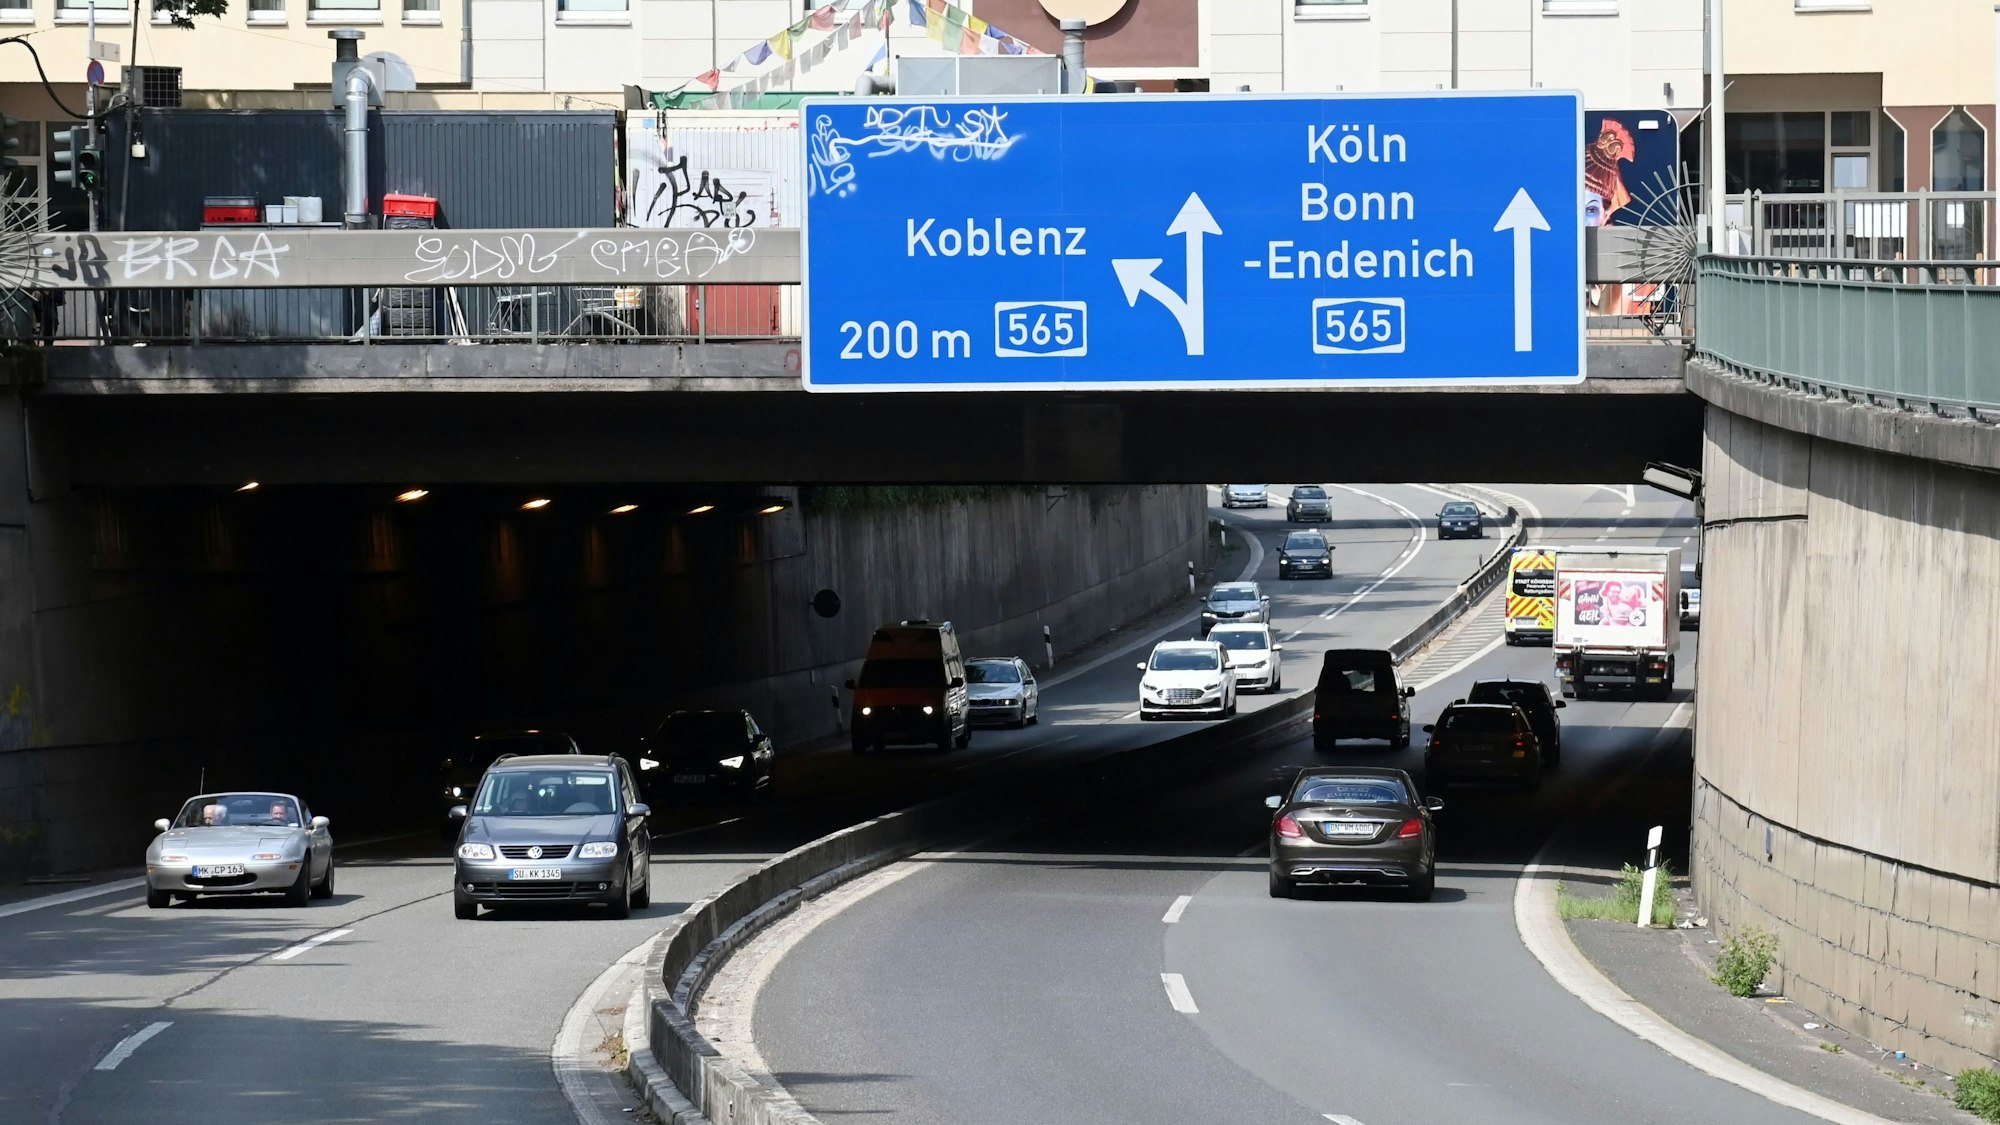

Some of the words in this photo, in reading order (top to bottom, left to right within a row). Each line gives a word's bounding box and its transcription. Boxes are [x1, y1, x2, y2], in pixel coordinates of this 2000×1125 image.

[1308, 124, 1407, 163] Köln
[1302, 182, 1414, 221] Bonn
[907, 217, 1087, 257] Koblenz
[1244, 238, 1474, 280] -Endenich
[840, 320, 918, 360] 200
[931, 329, 971, 358] m
[1008, 313, 1073, 346] 565
[1326, 309, 1392, 343] 565
[214, 866, 226, 874] CP
[227, 865, 243, 873] 163
[514, 869, 525, 878] SU
[529, 869, 540, 878] KK
[541, 869, 560, 878] 1345
